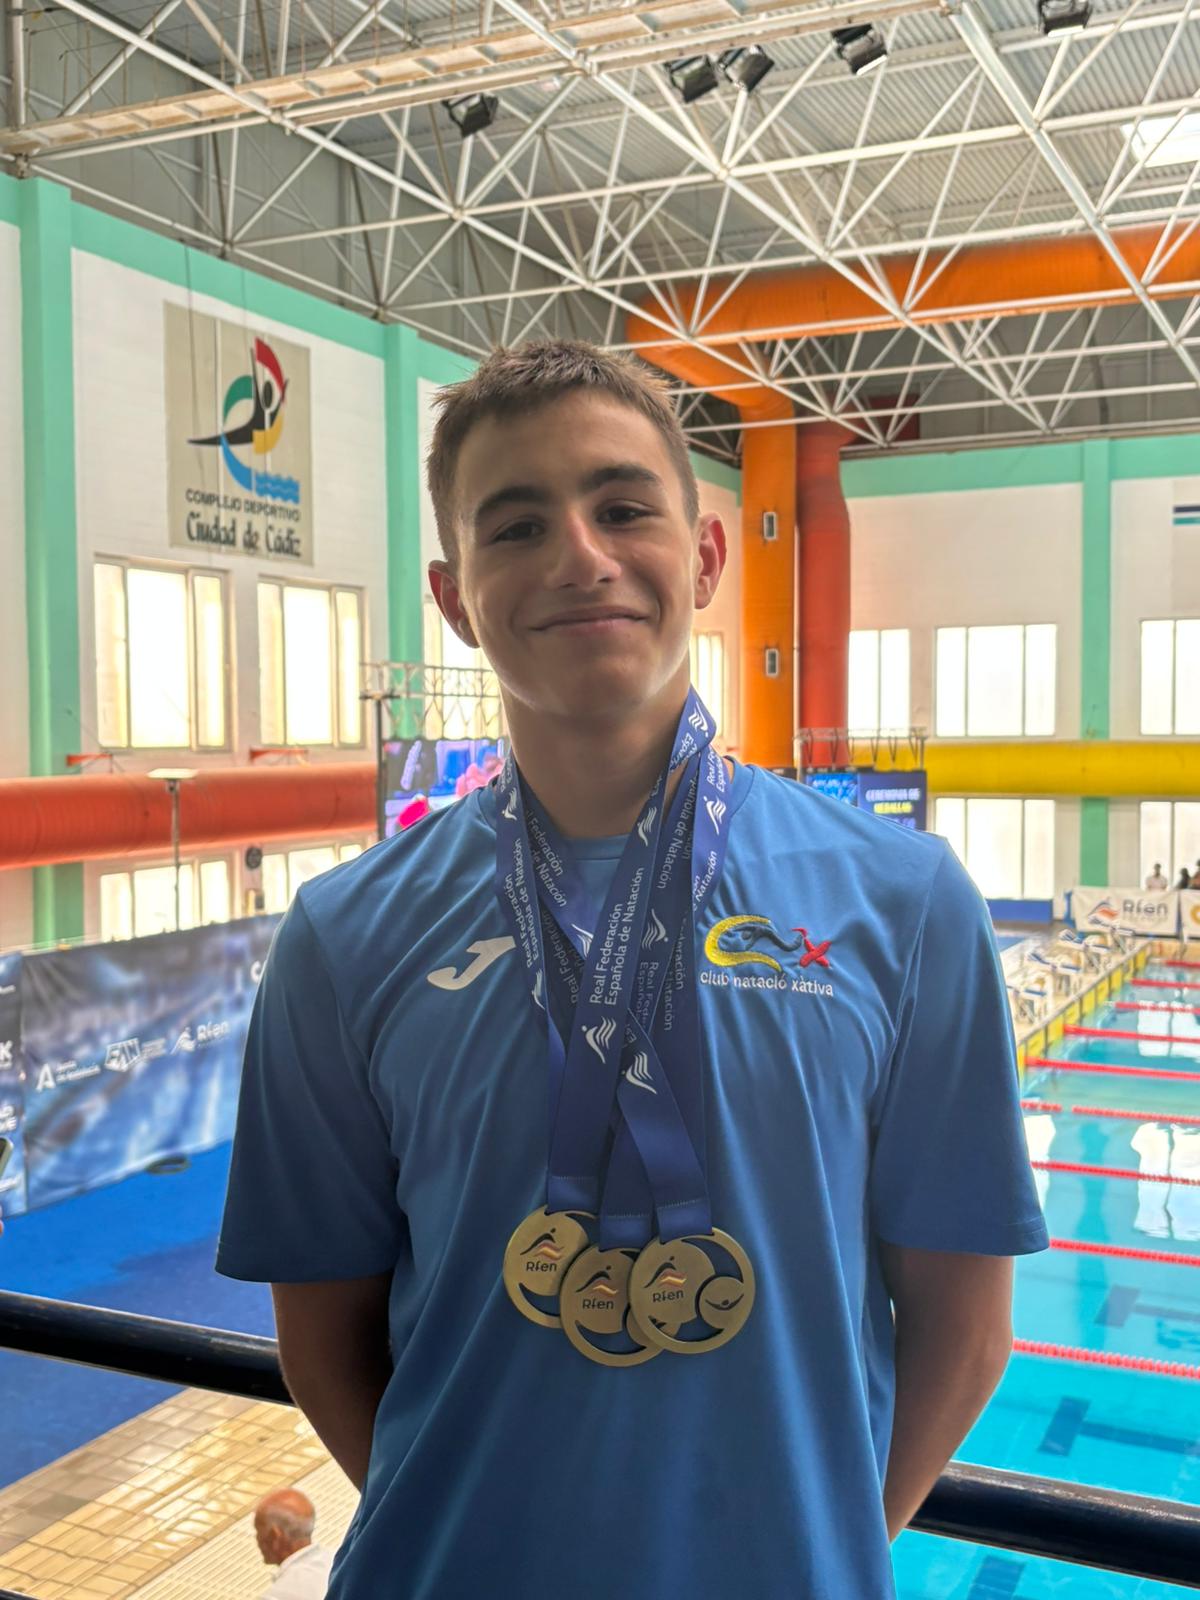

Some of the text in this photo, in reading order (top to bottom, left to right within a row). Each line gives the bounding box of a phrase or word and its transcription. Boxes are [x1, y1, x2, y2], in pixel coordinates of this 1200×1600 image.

[186, 488, 300, 522] COMPLEJO DEPORTIVO
[186, 511, 301, 557] Ciudad de Cádiz
[528, 818, 564, 877] Federación
[675, 820, 688, 836] de
[536, 862, 568, 908] Natación
[657, 837, 682, 889] Natación
[695, 850, 718, 903] Natación
[504, 873, 534, 969] Real Federación
[513, 838, 540, 961] Española de Natación
[589, 903, 623, 1005] Real Federación
[604, 867, 645, 1006] Española de Natación
[700, 970, 834, 997] club natació xàtiva
[526, 1261, 557, 1272] Rfen
[582, 1298, 614, 1310] Rfen
[652, 1290, 684, 1303] Rfen
